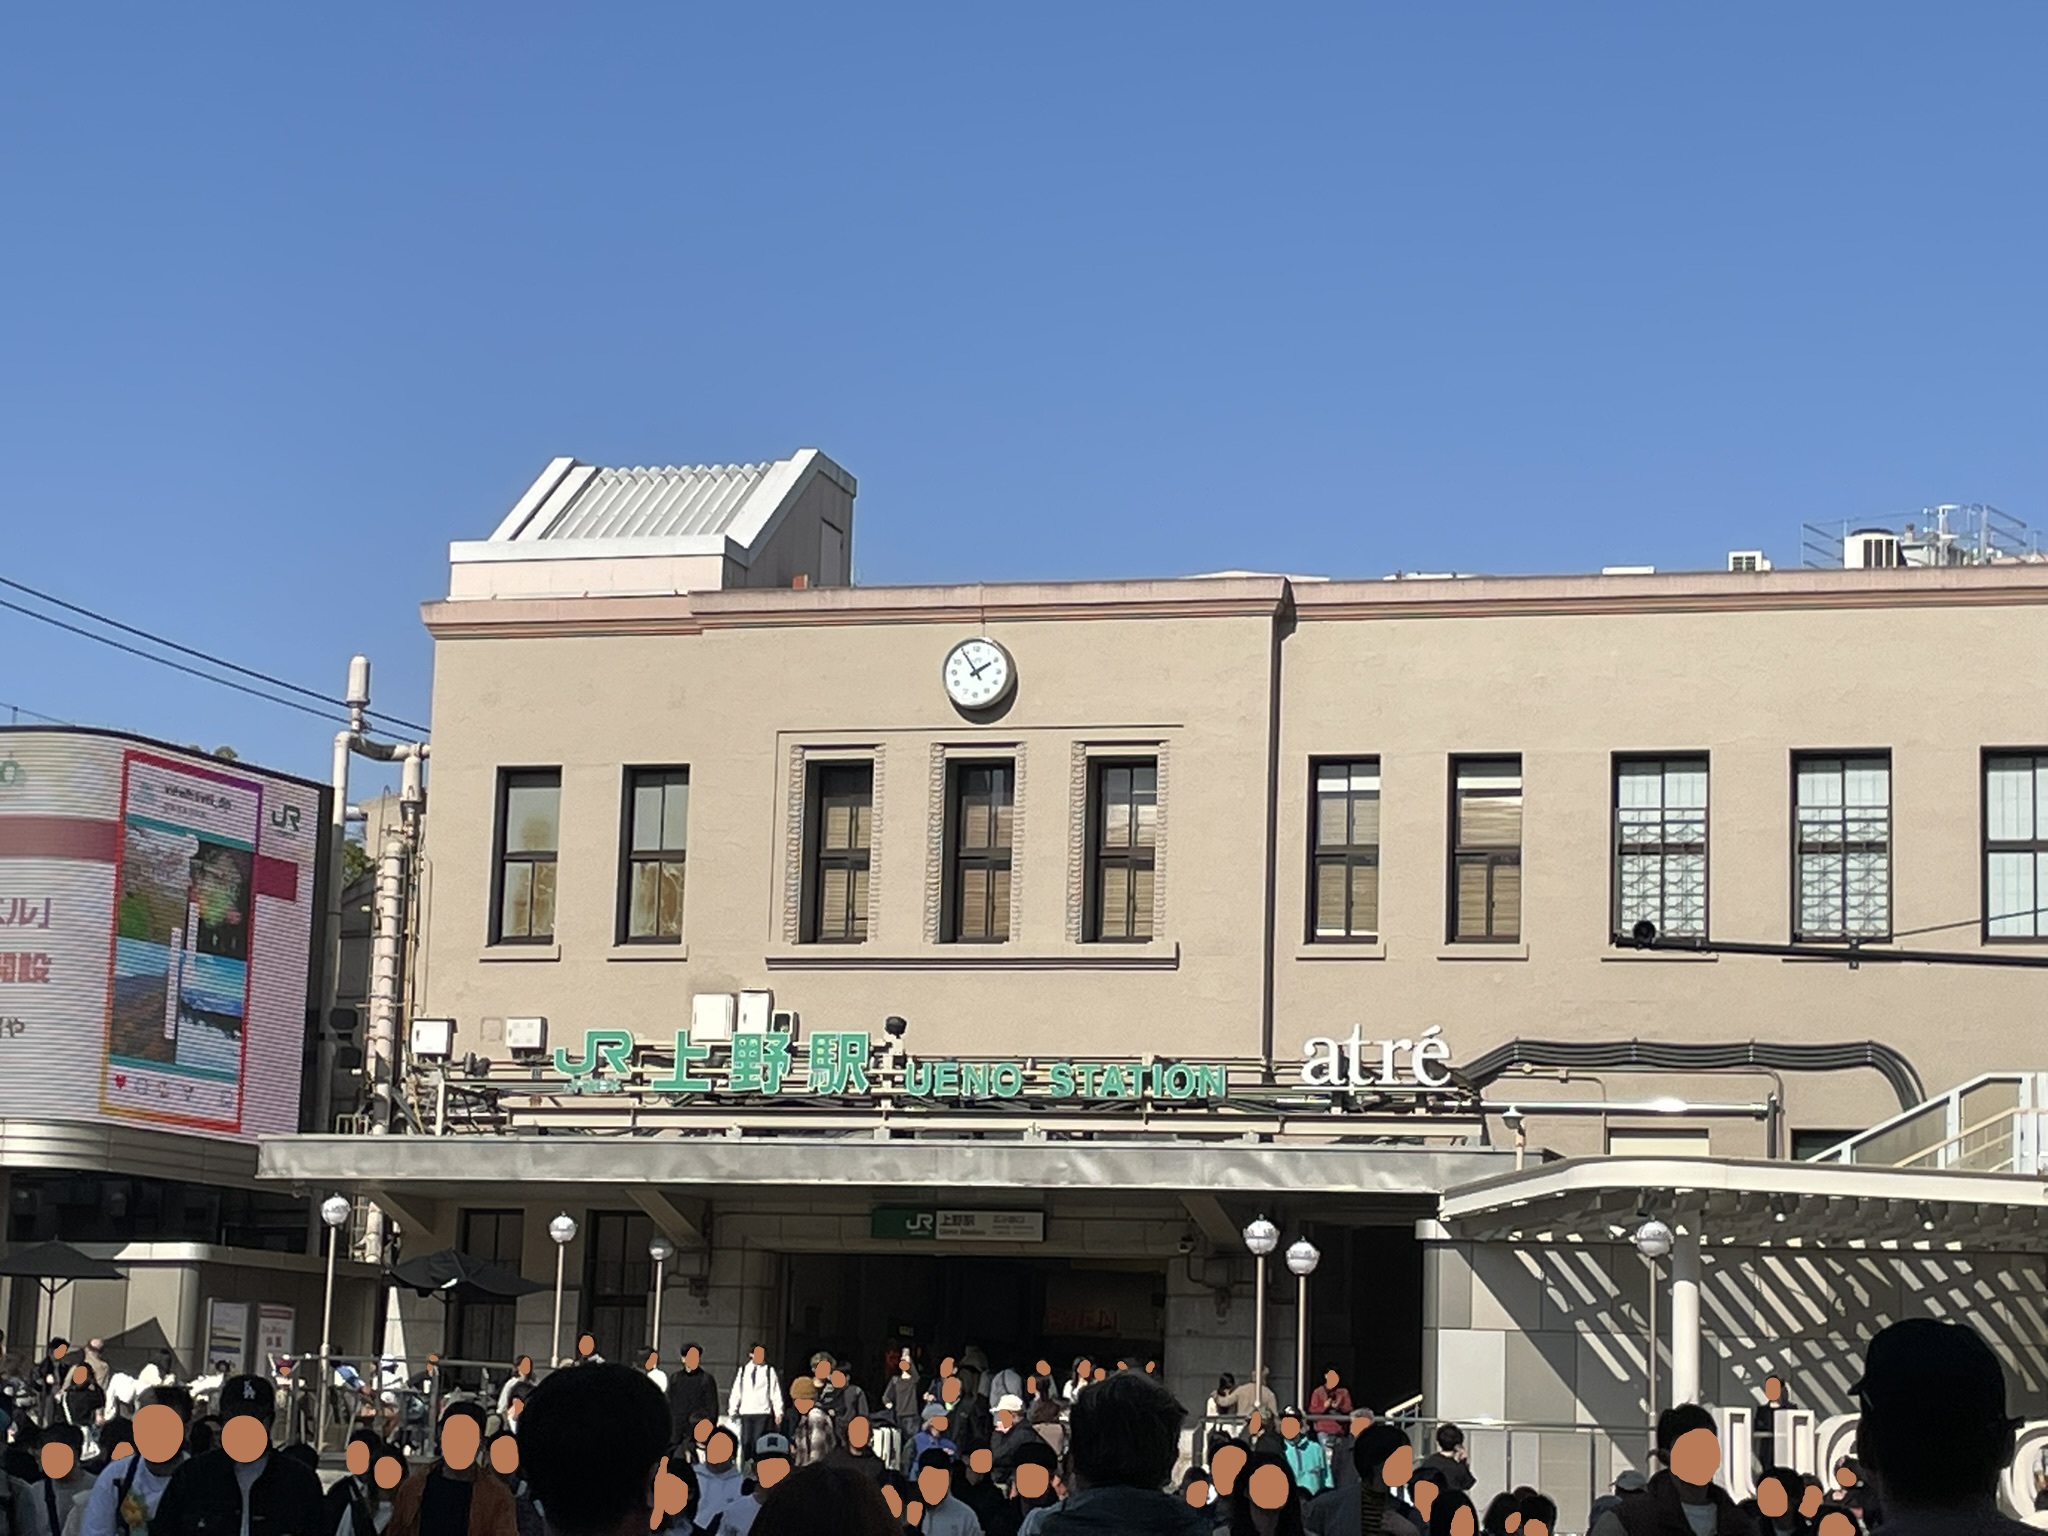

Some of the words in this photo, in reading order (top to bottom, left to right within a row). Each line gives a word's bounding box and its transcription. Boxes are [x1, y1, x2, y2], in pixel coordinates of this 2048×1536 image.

[272, 804, 300, 832] JR
[553, 1029, 634, 1077] JR
[651, 1029, 871, 1095] 上野駅
[904, 1062, 1023, 1097] UENO
[1049, 1063, 1227, 1098] STATION
[1301, 1023, 1452, 1087] atré
[905, 1213, 934, 1230] JR
